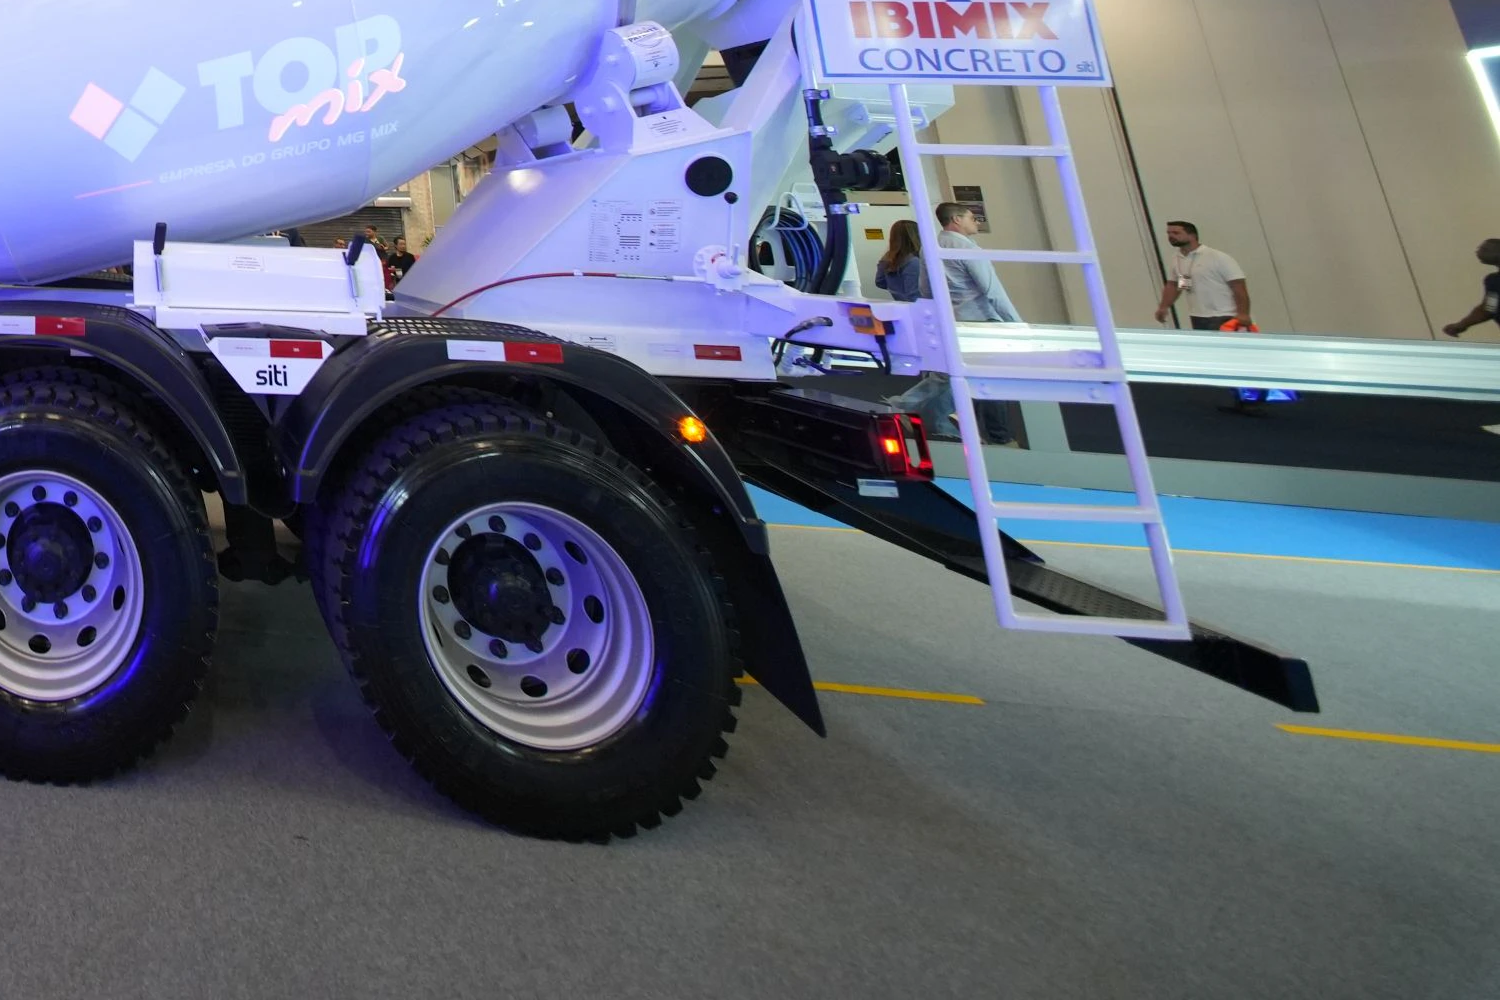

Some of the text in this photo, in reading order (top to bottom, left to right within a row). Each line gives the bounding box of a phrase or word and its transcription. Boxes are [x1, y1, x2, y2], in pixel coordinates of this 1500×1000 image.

[850, 1, 1059, 40] IBIMIX
[197, 14, 402, 131] TOP
[859, 48, 1066, 73] CONCRETO
[1076, 61, 1095, 73] siti
[268, 52, 406, 142] mix
[159, 121, 399, 183] EMPRESA DO GRUPO MG MIX
[256, 365, 288, 387] siti
